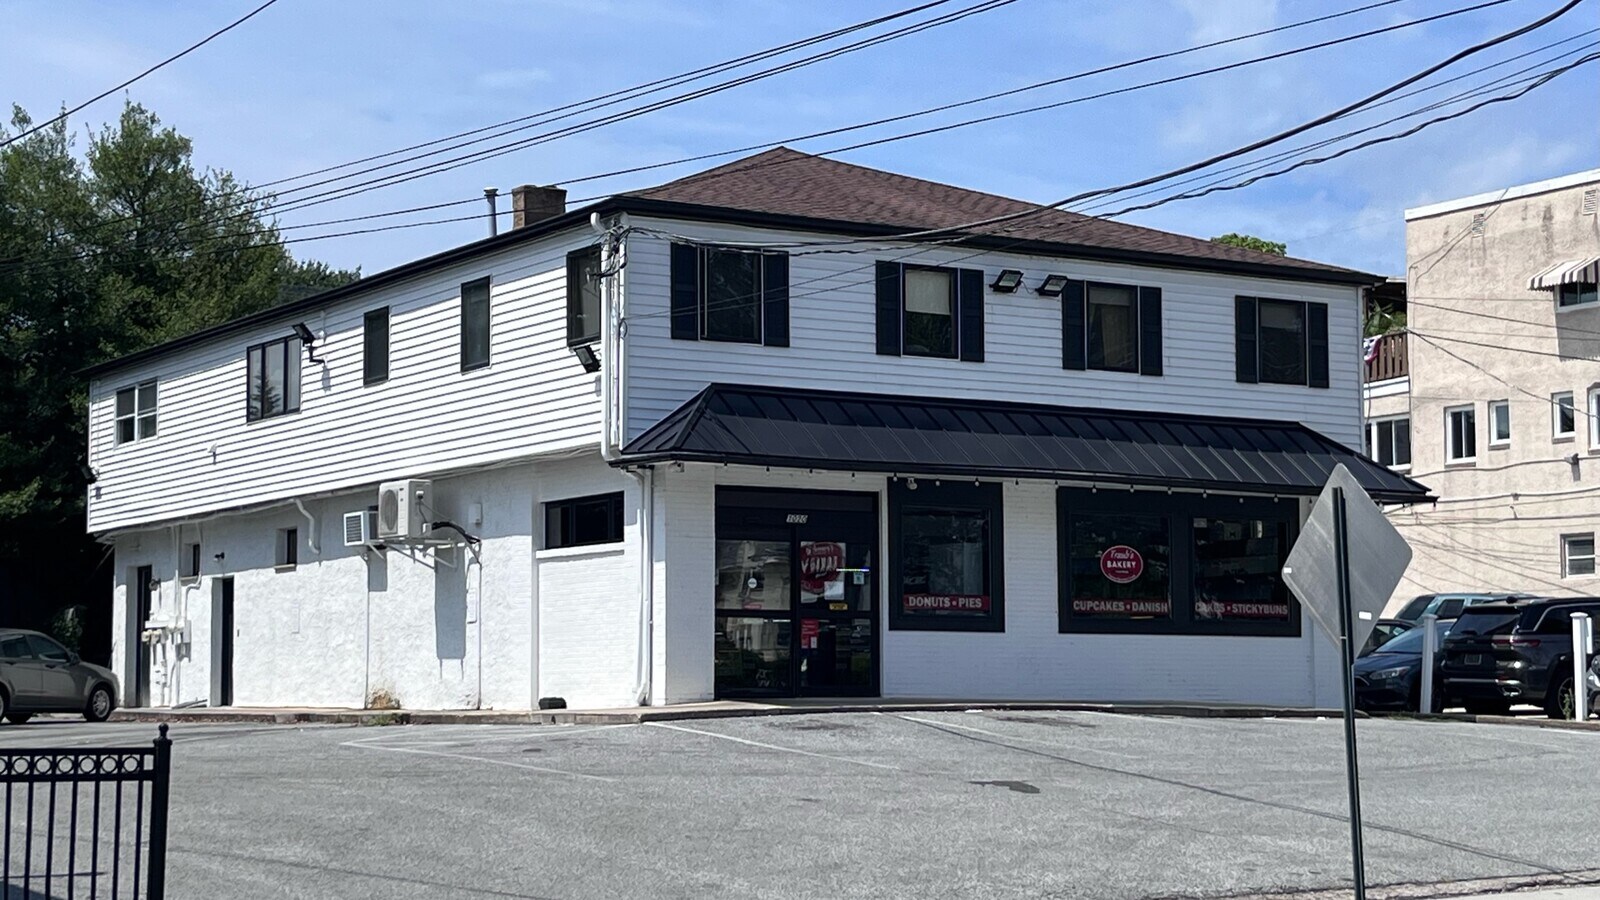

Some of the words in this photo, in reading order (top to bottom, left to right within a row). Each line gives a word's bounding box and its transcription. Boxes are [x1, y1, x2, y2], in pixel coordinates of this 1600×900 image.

[1106, 560, 1136, 569] BAKERY
[908, 596, 950, 608] DONUTS
[958, 598, 982, 608] PIES
[1073, 600, 1125, 611] CUPCAKES
[1132, 602, 1168, 613] DANISH
[1232, 604, 1288, 615] STICKYBUNS
